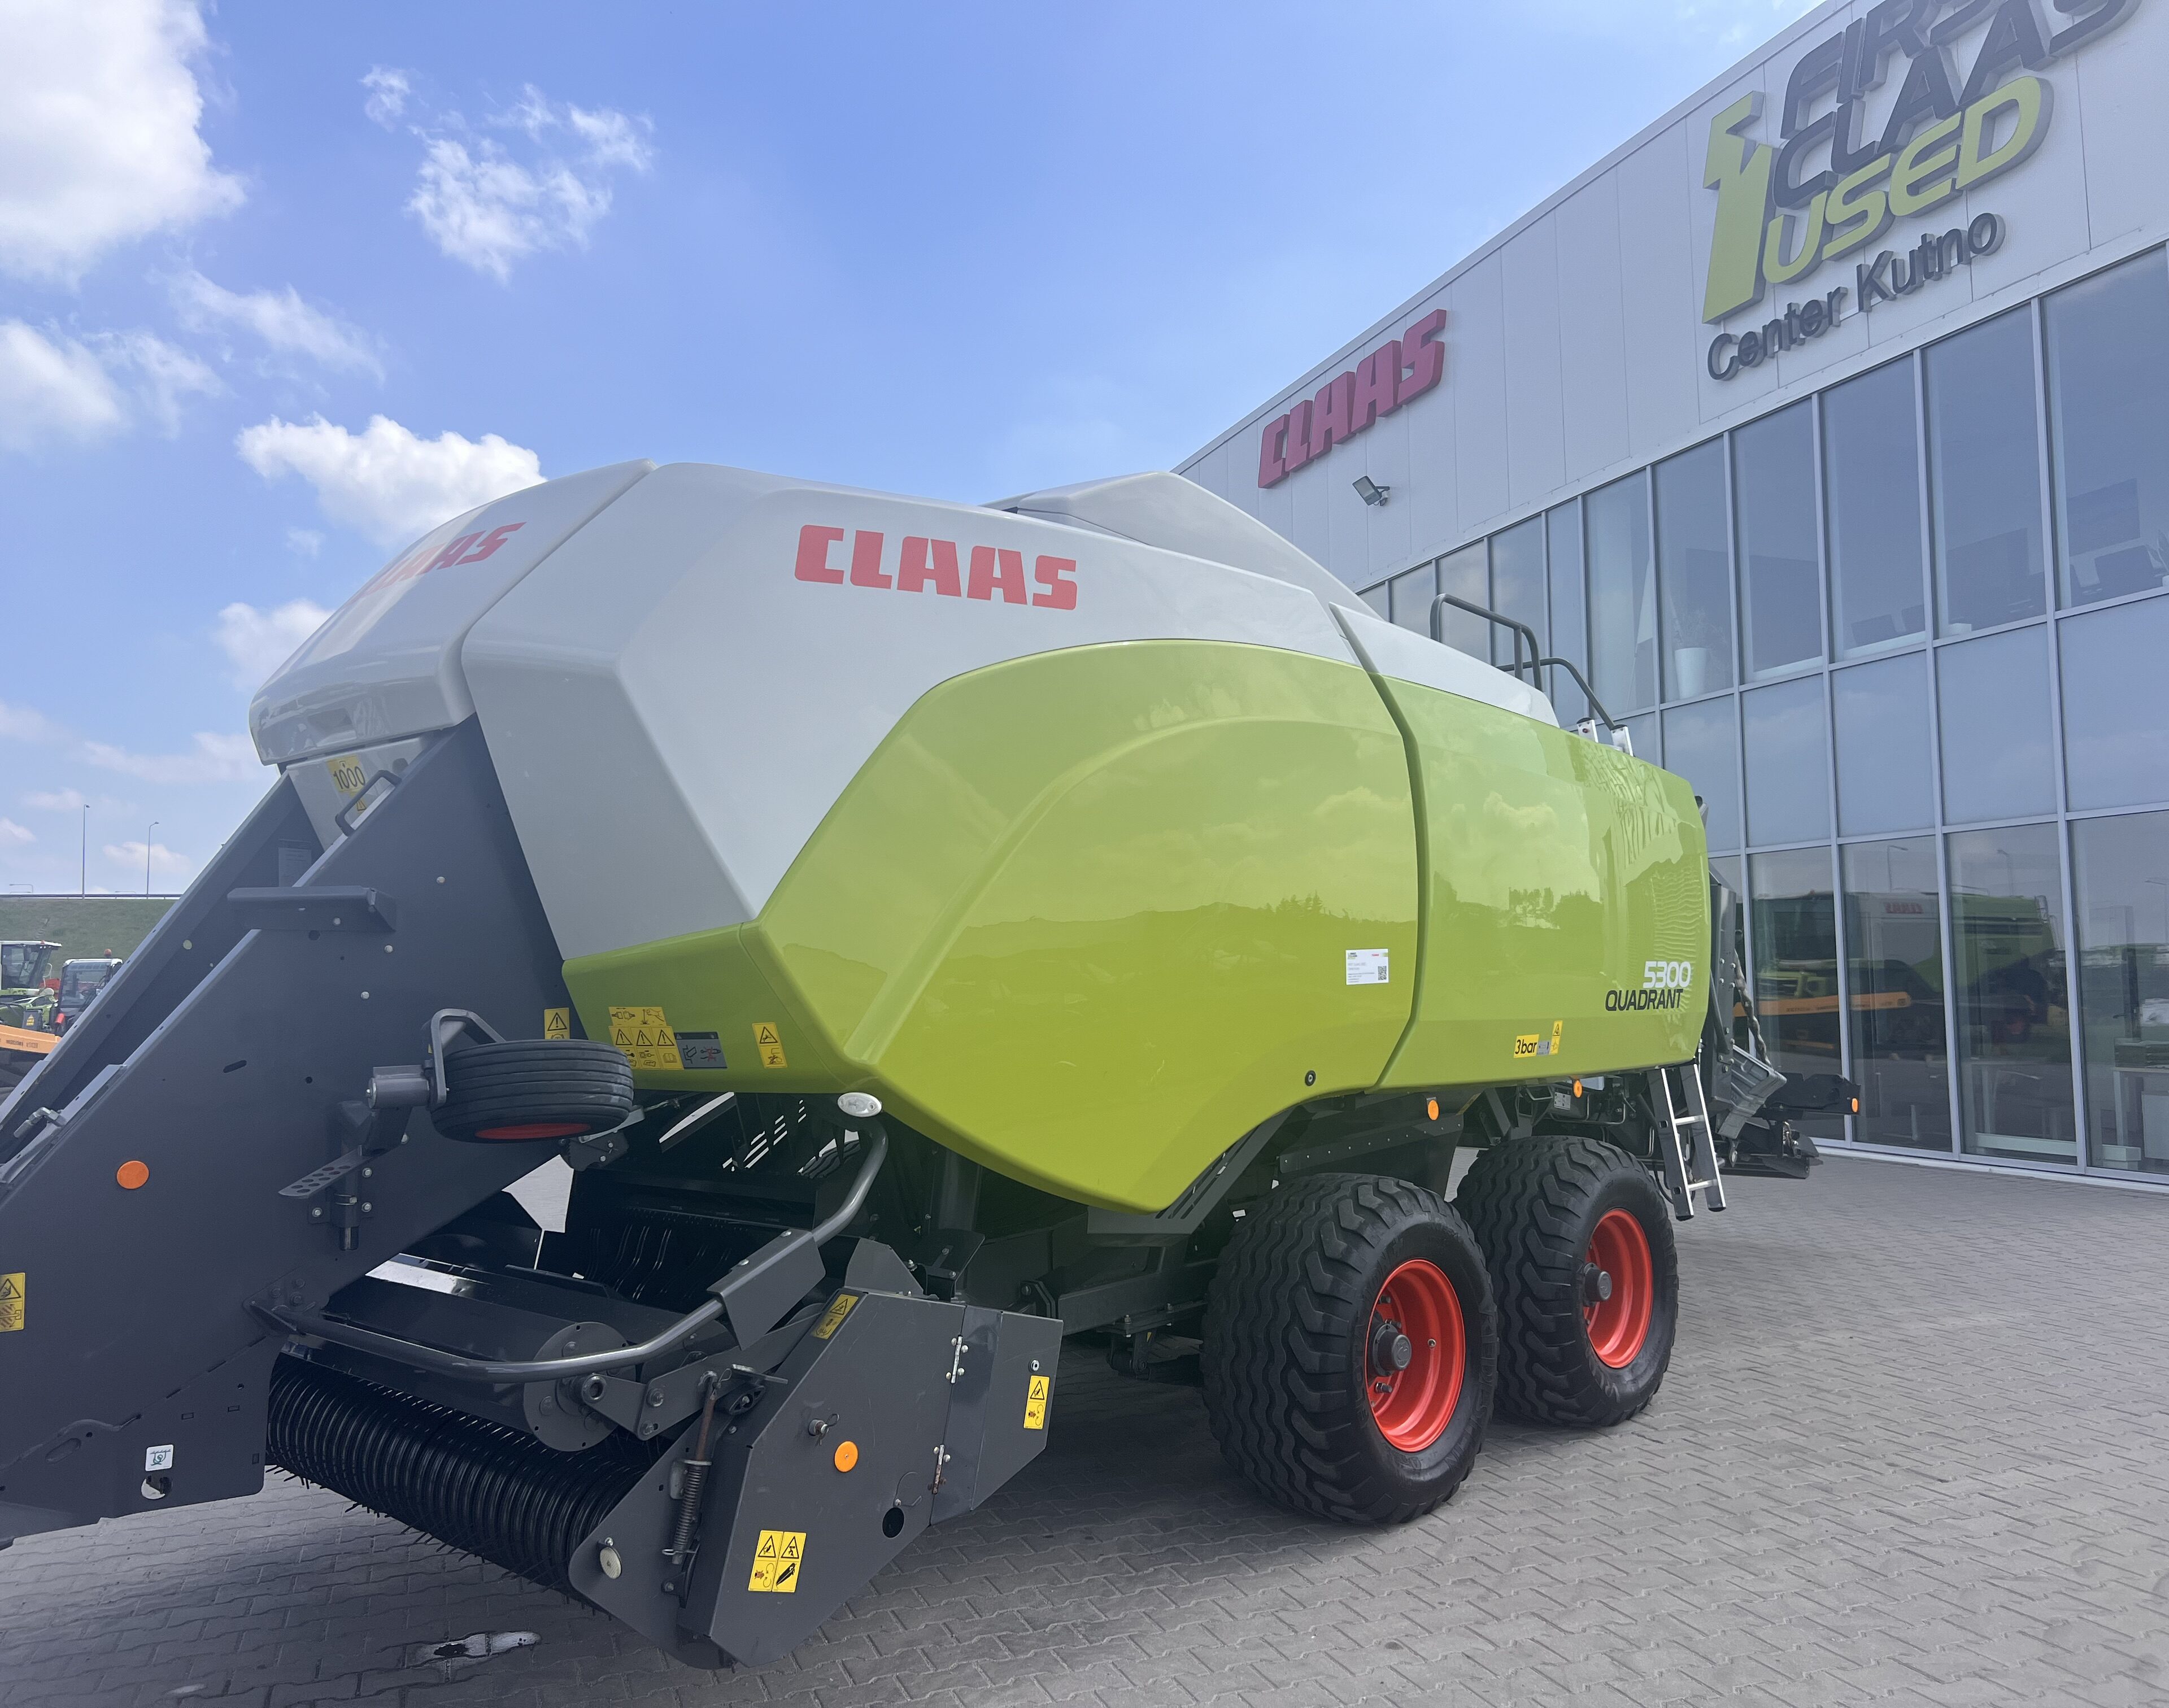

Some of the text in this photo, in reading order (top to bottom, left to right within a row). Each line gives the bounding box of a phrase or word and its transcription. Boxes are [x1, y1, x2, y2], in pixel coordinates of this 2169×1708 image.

[1780, 0, 2005, 138] FIR
[1762, 76, 2052, 284] USED
[1708, 212, 2005, 380] Center Kutno
[1258, 309, 1447, 489] CLAAS
[794, 525, 1078, 611] CLAAS
[333, 766, 366, 789] 1000
[1605, 989, 1683, 1011] QUADRANT
[1643, 961, 1691, 988] 5300
